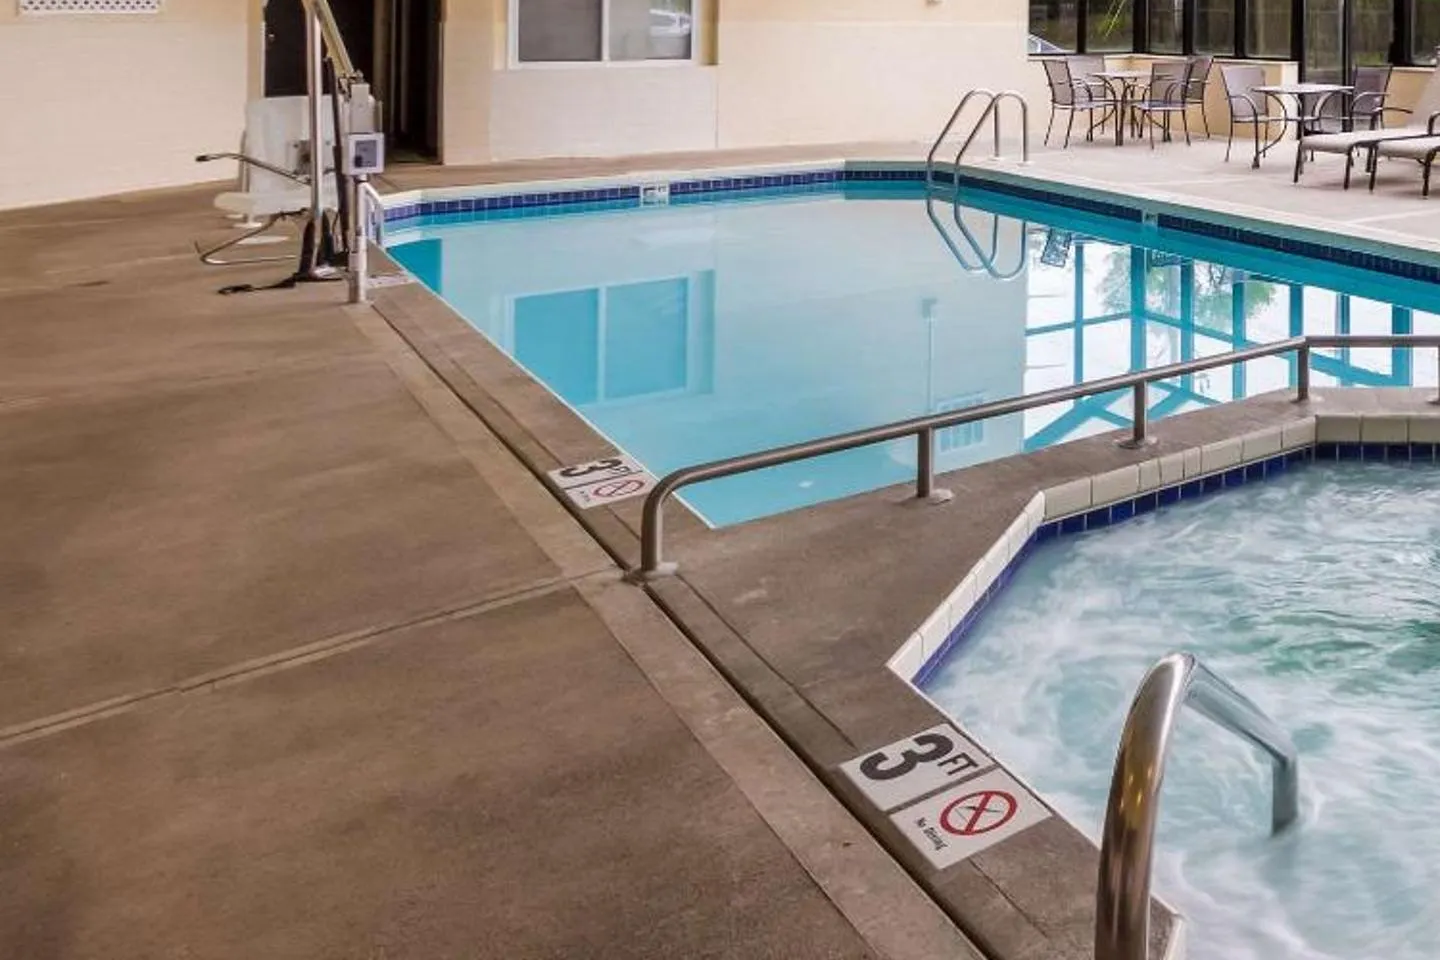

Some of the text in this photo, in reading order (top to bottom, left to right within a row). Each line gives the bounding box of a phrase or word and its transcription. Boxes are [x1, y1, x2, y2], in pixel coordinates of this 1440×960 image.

[559, 459, 623, 477] 3
[859, 732, 979, 781] 3 FT
